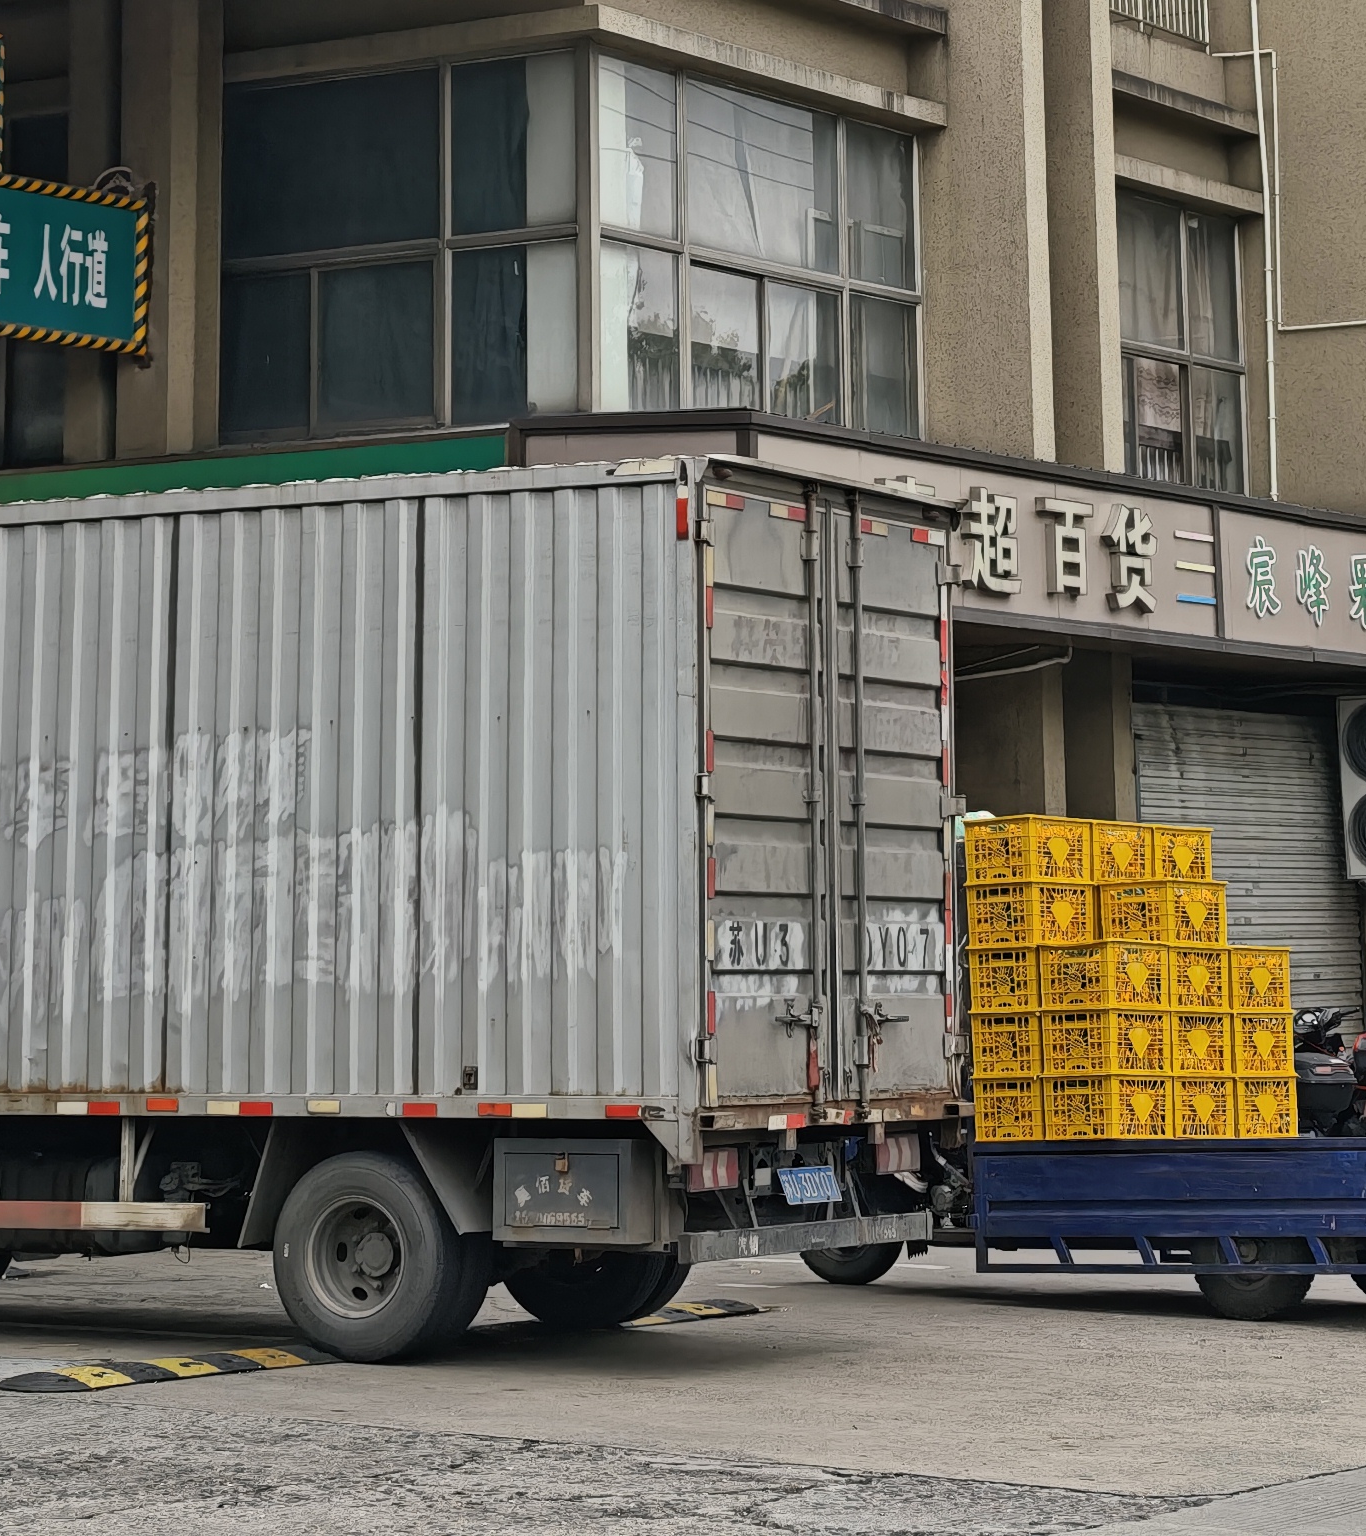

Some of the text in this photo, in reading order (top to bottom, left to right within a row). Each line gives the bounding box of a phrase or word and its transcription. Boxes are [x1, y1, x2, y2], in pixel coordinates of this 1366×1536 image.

[33, 224, 109, 309] 人行道
[874, 475, 1158, 614] 超百货
